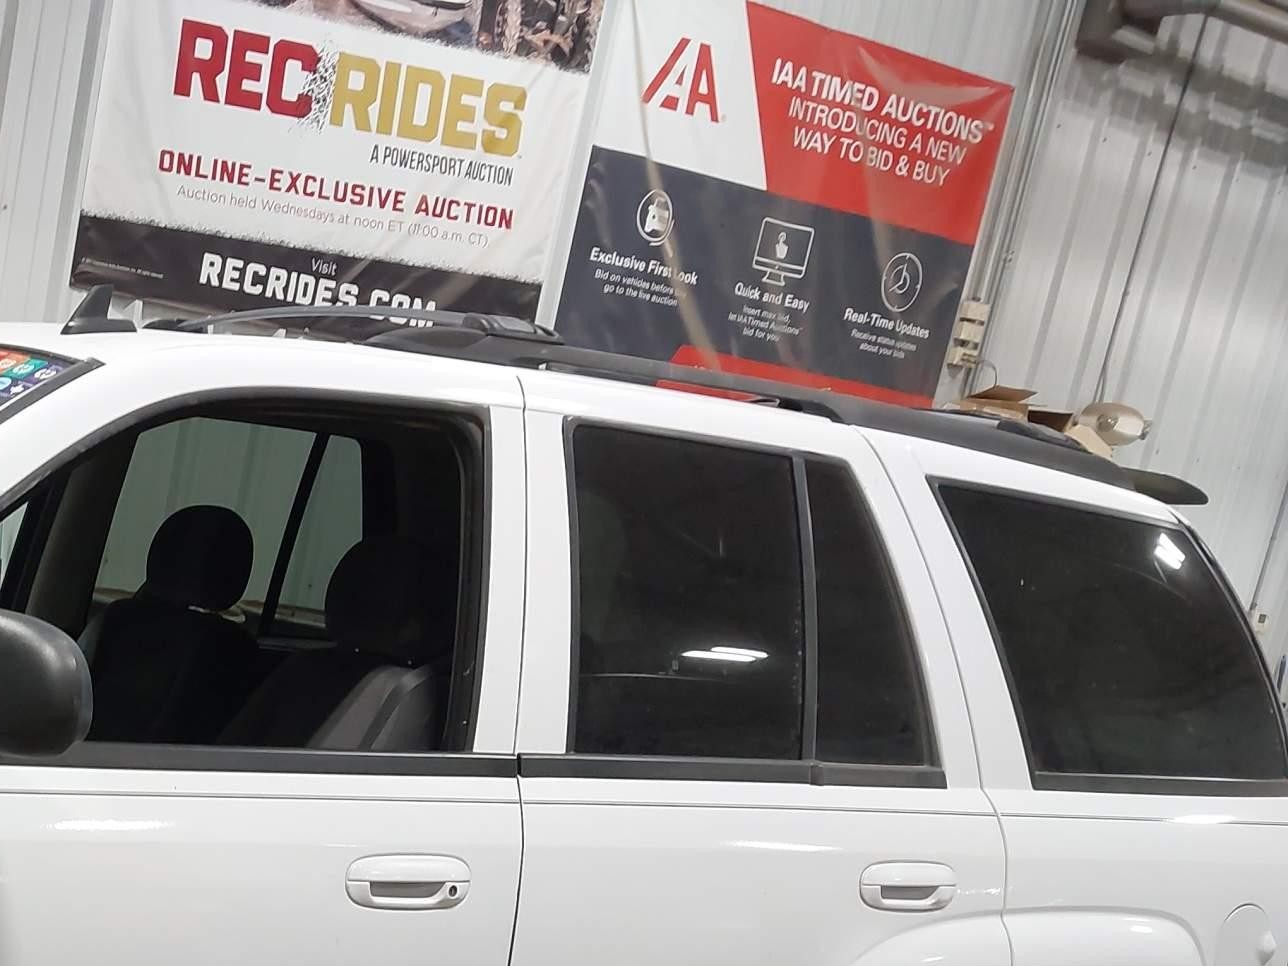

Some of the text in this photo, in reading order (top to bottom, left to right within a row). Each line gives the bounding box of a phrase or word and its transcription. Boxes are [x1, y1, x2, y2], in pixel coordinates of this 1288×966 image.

[772, 58, 807, 93] IAA
[811, 71, 880, 112] TIMED
[789, 96, 967, 165] INTRODUCING A NEW
[370, 144, 514, 186] A POWERSPORT AUCTION
[794, 126, 950, 186] WAY TO BID & BUY
[158, 149, 514, 230] ONLINE-EXCLUSIVE AUCTION
[177, 184, 227, 206] Auction
[229, 193, 257, 209] held
[261, 200, 336, 224] Wednesdays
[337, 213, 350, 225] at
[353, 216, 384, 232] noon
[387, 219, 404, 232] ET
[311, 256, 338, 276] Visit
[589, 246, 646, 272] Exclusive
[647, 259, 672, 279] First
[594, 268, 610, 280] Bid
[609, 273, 621, 283] on
[621, 275, 651, 290] vehicles
[603, 283, 615, 294] go
[615, 284, 624, 295] to
[625, 287, 639, 298] the
[650, 294, 678, 307] auction
[735, 282, 811, 313] Quick and Easy
[843, 307, 930, 339] Real-Time Updates
